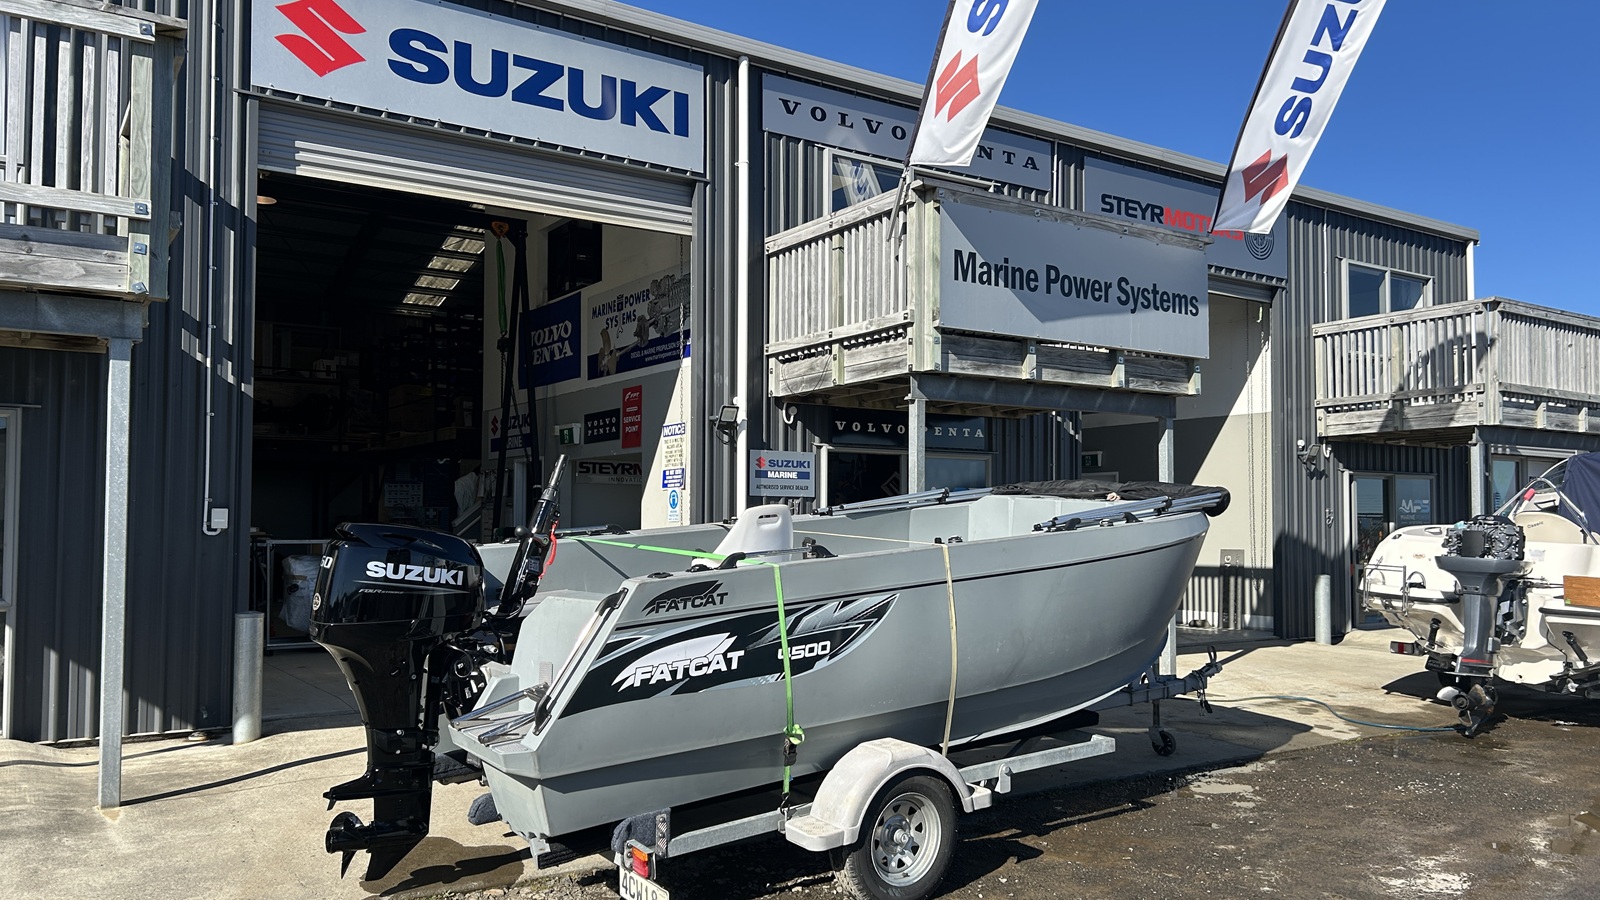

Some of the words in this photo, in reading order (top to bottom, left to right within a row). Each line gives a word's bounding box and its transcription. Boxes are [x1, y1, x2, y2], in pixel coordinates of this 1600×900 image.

[1274, 0, 1361, 139] SUZ
[387, 27, 689, 138] SUZUKI
[778, 97, 907, 141] VOLVO
[977, 145, 1040, 171] NTA
[953, 249, 1039, 292] Marine
[1045, 264, 1112, 303] Power
[1116, 276, 1200, 317] Systems
[591, 300, 616, 319] MARINE
[624, 288, 650, 309] POWER
[532, 340, 573, 366] ENTA
[507, 413, 531, 430] UZUK
[587, 417, 617, 428] VOLVO
[623, 415, 641, 424] SERVICE
[625, 425, 639, 433] POINT
[835, 420, 906, 435] VOLVO
[926, 426, 985, 438] ENTA
[587, 426, 617, 436] PENTA
[663, 424, 685, 437] NOTICE
[507, 436, 523, 449] RINE
[768, 459, 811, 468] SUZUKI
[767, 471, 798, 479] MARINE
[365, 561, 464, 586] SUZUKI
[654, 591, 729, 614] FATCAT
[777, 640, 831, 660] 4500
[633, 650, 745, 687] FATCAT
